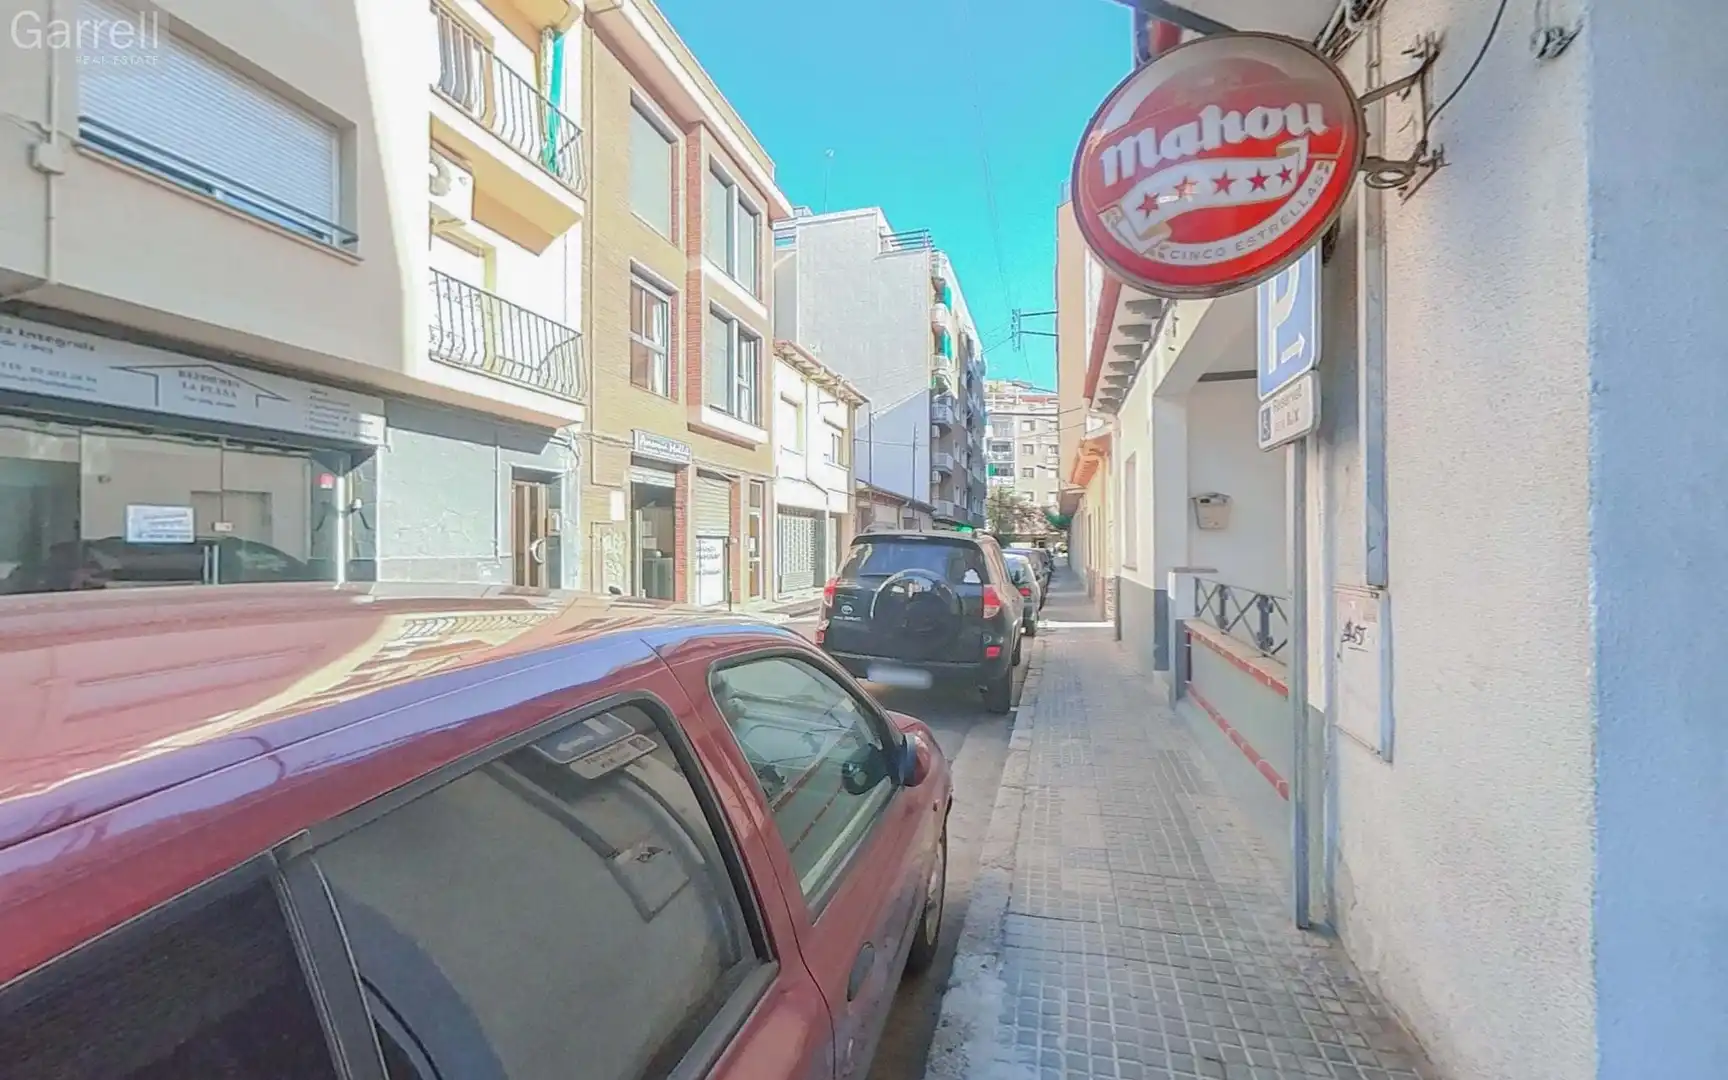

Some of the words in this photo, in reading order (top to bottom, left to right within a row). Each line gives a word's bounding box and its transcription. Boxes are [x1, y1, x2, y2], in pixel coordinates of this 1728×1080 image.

[1100, 103, 1329, 187] Mahou
[1169, 247, 1227, 261] CINCO
[1235, 175, 1326, 252] ESTRELLAS
